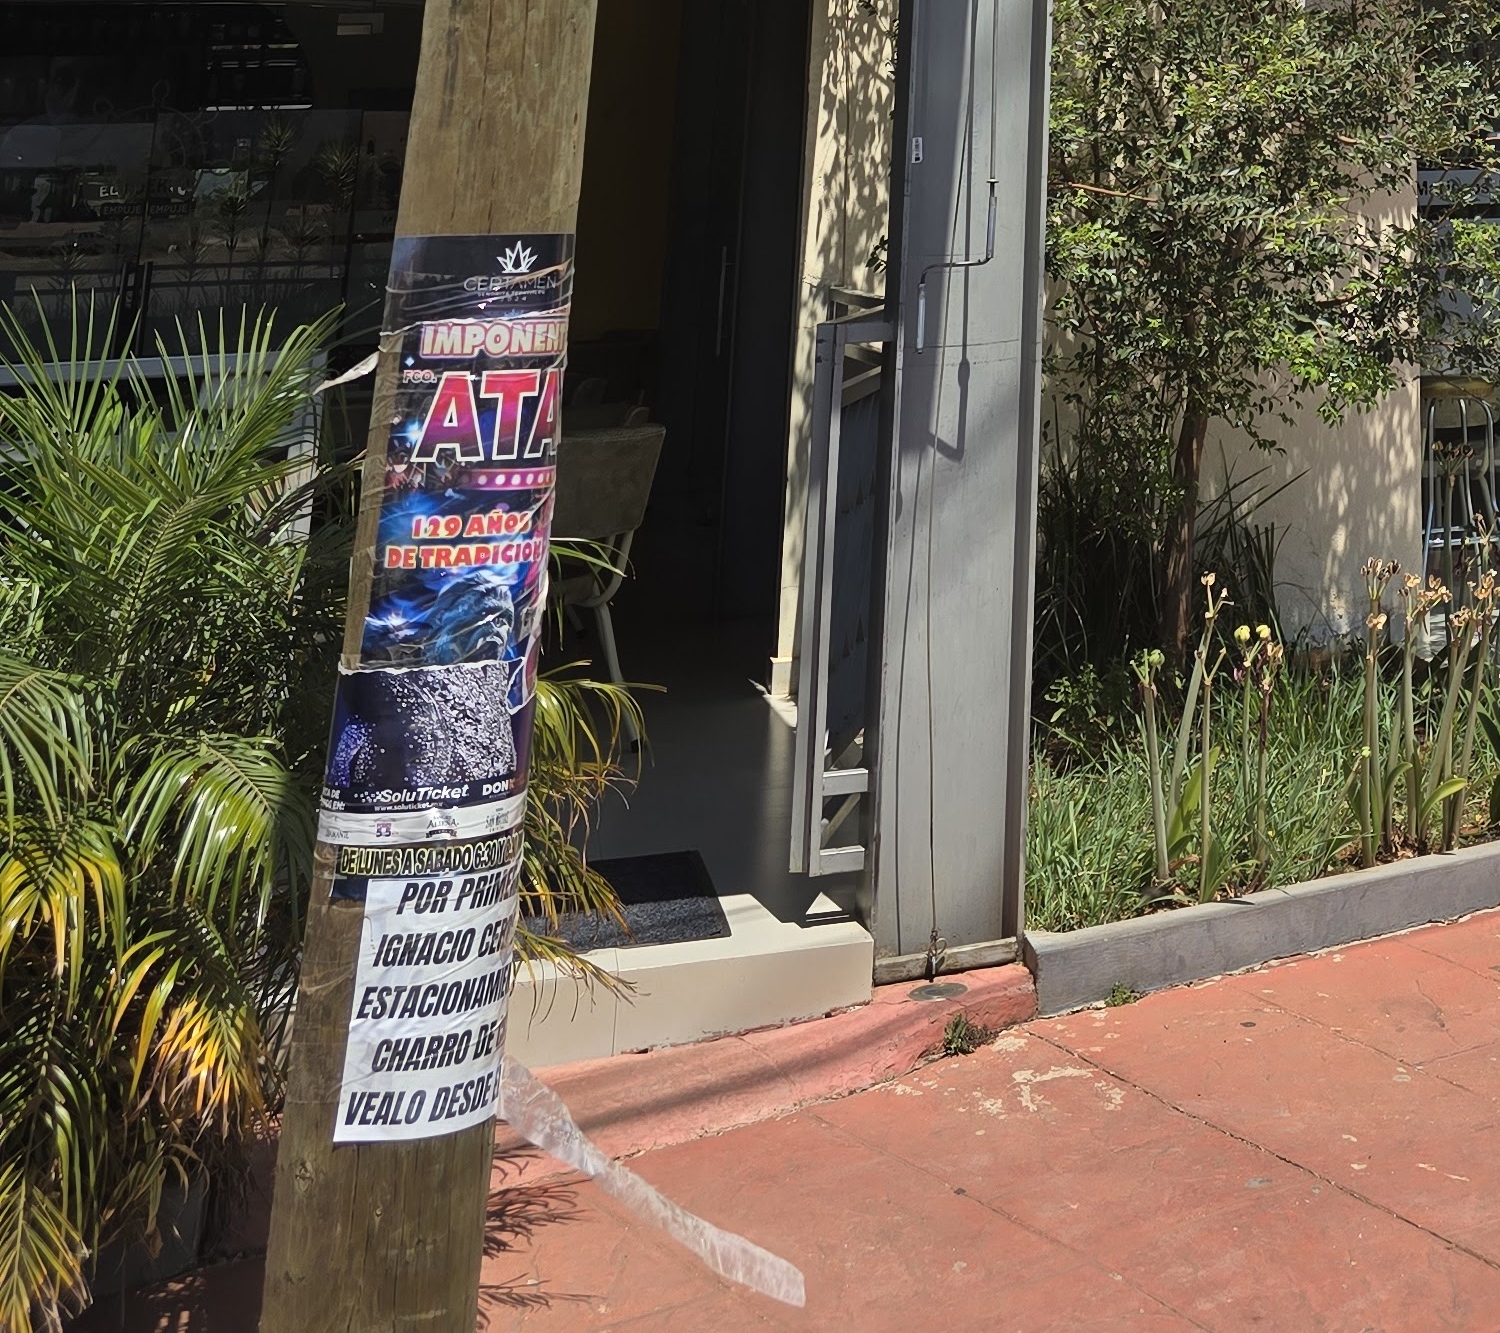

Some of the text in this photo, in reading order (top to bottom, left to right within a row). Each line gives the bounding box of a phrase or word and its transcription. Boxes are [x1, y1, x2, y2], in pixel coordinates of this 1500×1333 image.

[463, 275, 557, 291] CERTAMEN
[403, 369, 438, 384] FCO.
[412, 509, 533, 539] 129 AÑOS
[385, 544, 418, 569] DE
[380, 784, 470, 803] SoluTicket
[341, 847, 357, 875] DE
[357, 847, 400, 876] LUNES
[399, 847, 414, 876] A
[415, 844, 473, 876] SABADO
[473, 840, 498, 870] 6:30
[396, 879, 453, 916] POR
[372, 928, 477, 968] IGNACIO
[371, 1029, 473, 1073] CHARRO
[472, 1019, 498, 1061] DE
[344, 1090, 427, 1126] VEALO
[428, 1070, 494, 1123] DESDE
